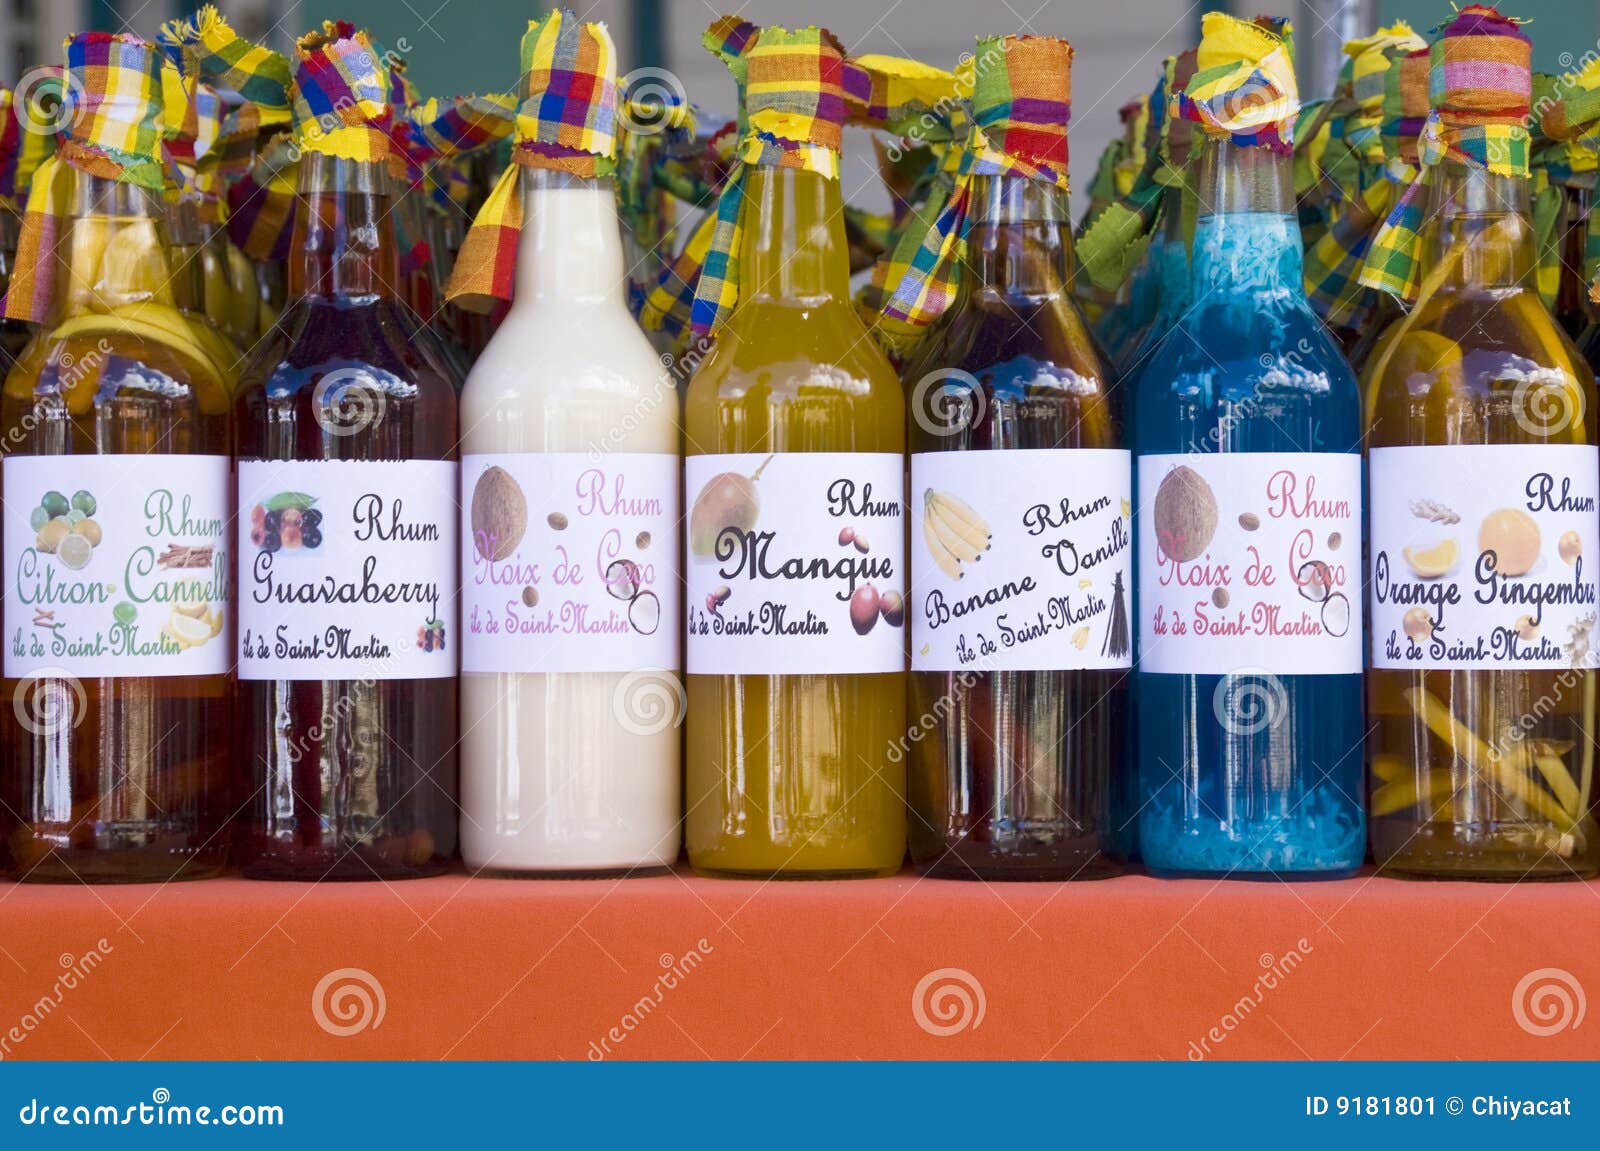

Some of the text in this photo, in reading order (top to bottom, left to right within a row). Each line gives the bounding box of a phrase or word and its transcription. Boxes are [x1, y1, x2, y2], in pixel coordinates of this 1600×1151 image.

[144, 489, 223, 537] Rhum
[576, 469, 662, 516] Rhum
[827, 479, 900, 517] Rhum
[1023, 496, 1111, 535] Rhum
[1266, 470, 1351, 518] Rhum
[1526, 472, 1595, 512] Rhum
[353, 493, 440, 541] Rhum
[17, 547, 109, 604] Citron
[473, 528, 656, 585] Noix de Coco
[715, 526, 893, 602] Mangue
[925, 516, 1128, 630] Banane Vanille
[1157, 529, 1346, 586] Noix de Coco
[253, 550, 440, 625] Guavaberry
[1375, 549, 1596, 626] Orange Gingembre
[31, 633, 45, 657] de
[52, 623, 184, 657] Saint-Martin
[486, 610, 499, 634] de
[505, 600, 630, 634] Saint-Martin
[699, 611, 709, 635] de
[713, 601, 828, 635] Saint-Martin
[977, 633, 997, 656] de
[997, 594, 1106, 647] Saint-Martin
[1172, 611, 1187, 636] de
[1194, 601, 1322, 636] Saint-Martin
[257, 635, 270, 659] de
[275, 625, 391, 659] Saint-Martin
[1406, 636, 1423, 660] de
[1429, 626, 1562, 661] Saint-Martin
